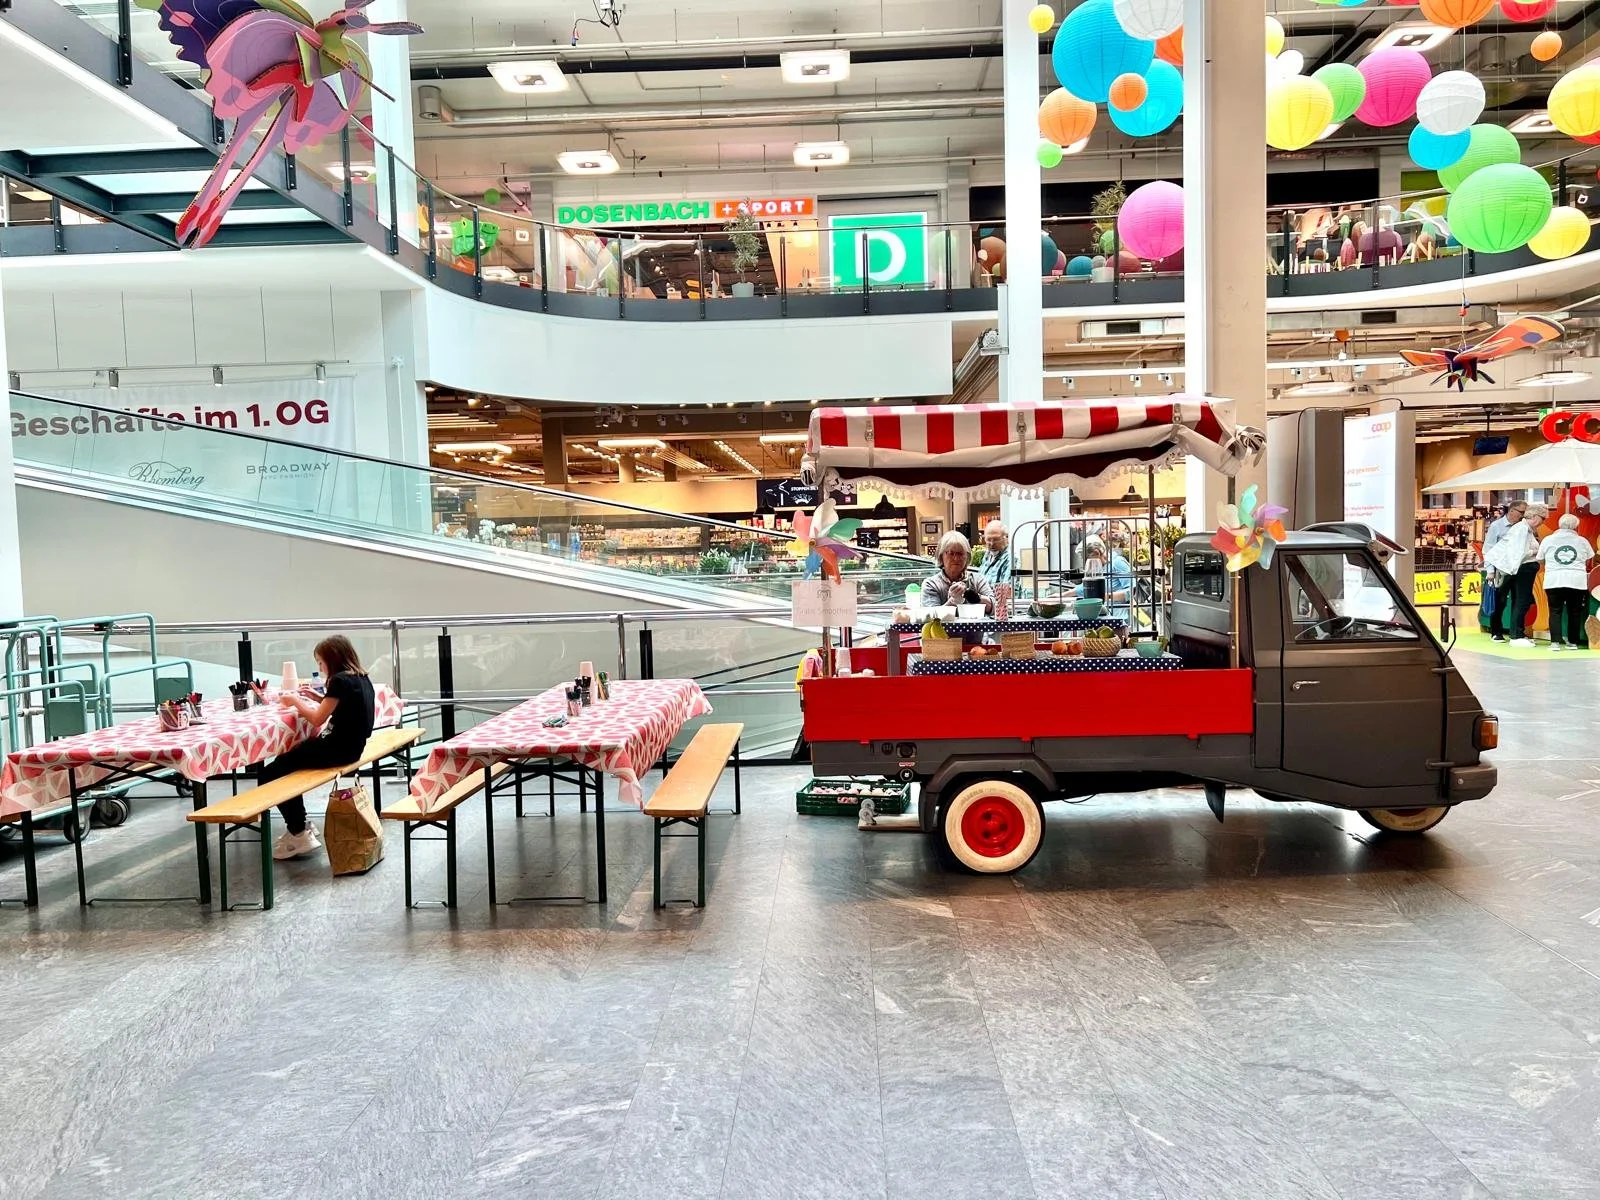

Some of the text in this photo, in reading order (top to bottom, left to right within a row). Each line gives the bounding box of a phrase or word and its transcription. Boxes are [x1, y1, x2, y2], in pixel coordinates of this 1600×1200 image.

[558, 201, 710, 224] DOSENBACH
[854, 230, 907, 282] D
[194, 406, 238, 429] im
[128, 460, 205, 490] Rhomberg
[246, 462, 331, 475] BROADWAY
[1415, 579, 1441, 593] tion
